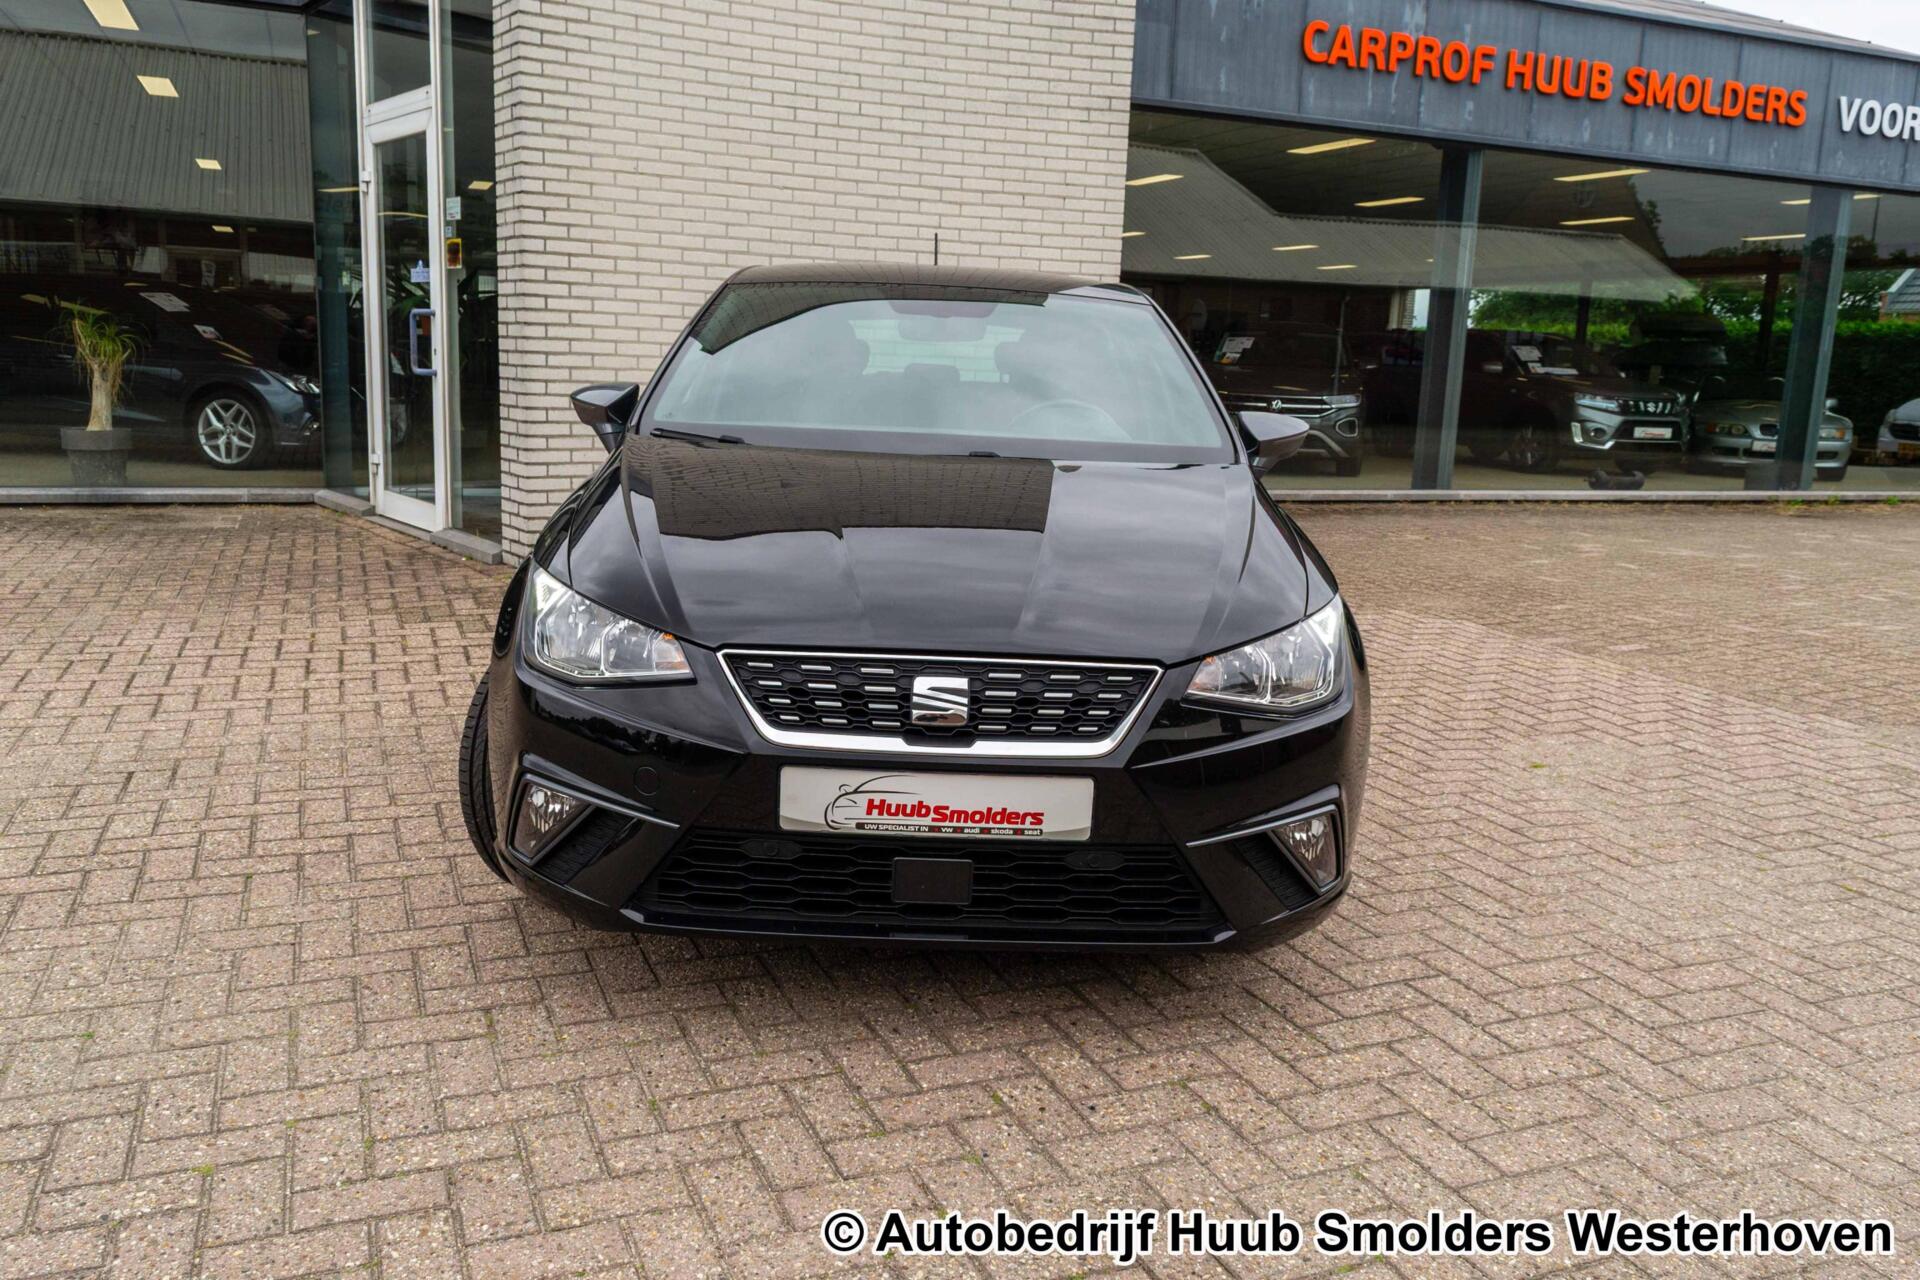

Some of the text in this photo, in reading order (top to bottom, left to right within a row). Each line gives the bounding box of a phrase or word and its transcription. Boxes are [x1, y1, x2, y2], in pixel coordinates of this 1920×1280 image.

[1303, 19, 1808, 127] CARPROF HUUB SMOLDERS
[1840, 95, 1920, 141] VOOR
[878, 824, 919, 832] SPECIALIST
